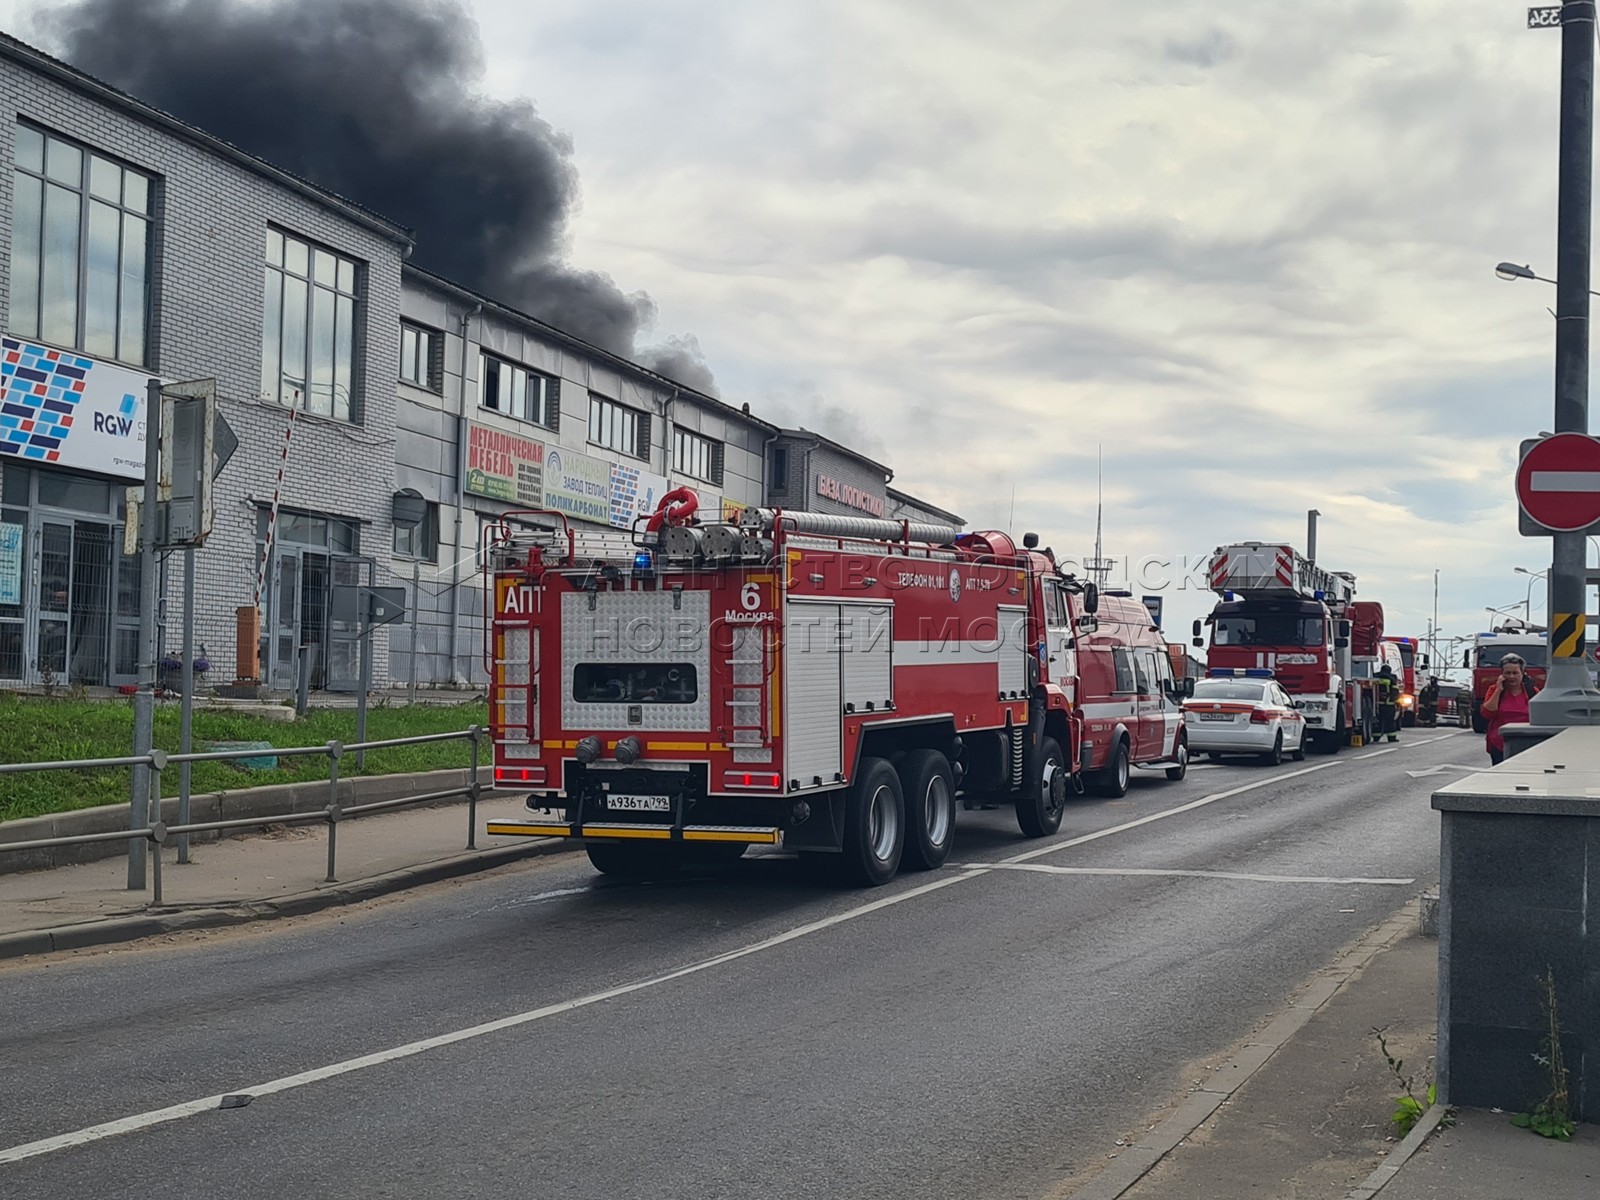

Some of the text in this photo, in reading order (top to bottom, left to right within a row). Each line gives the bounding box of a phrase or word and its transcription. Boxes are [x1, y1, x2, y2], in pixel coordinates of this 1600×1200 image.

[94, 411, 133, 437] RGW
[470, 425, 543, 464] МЕТАЛЛИЧЕСКАЯ
[469, 446, 514, 477] МЕБЕЛЬ
[563, 476, 608, 500] ЗАВОД ТЕПЛИЦ
[818, 474, 841, 502] БАЗА
[545, 492, 608, 519] ПОЛИКАРБОНАТ
[898, 572, 928, 587] ТЕЛЕФОН
[504, 586, 546, 613] АПТ
[741, 582, 761, 611] 6
[725, 609, 774, 622] Москва
